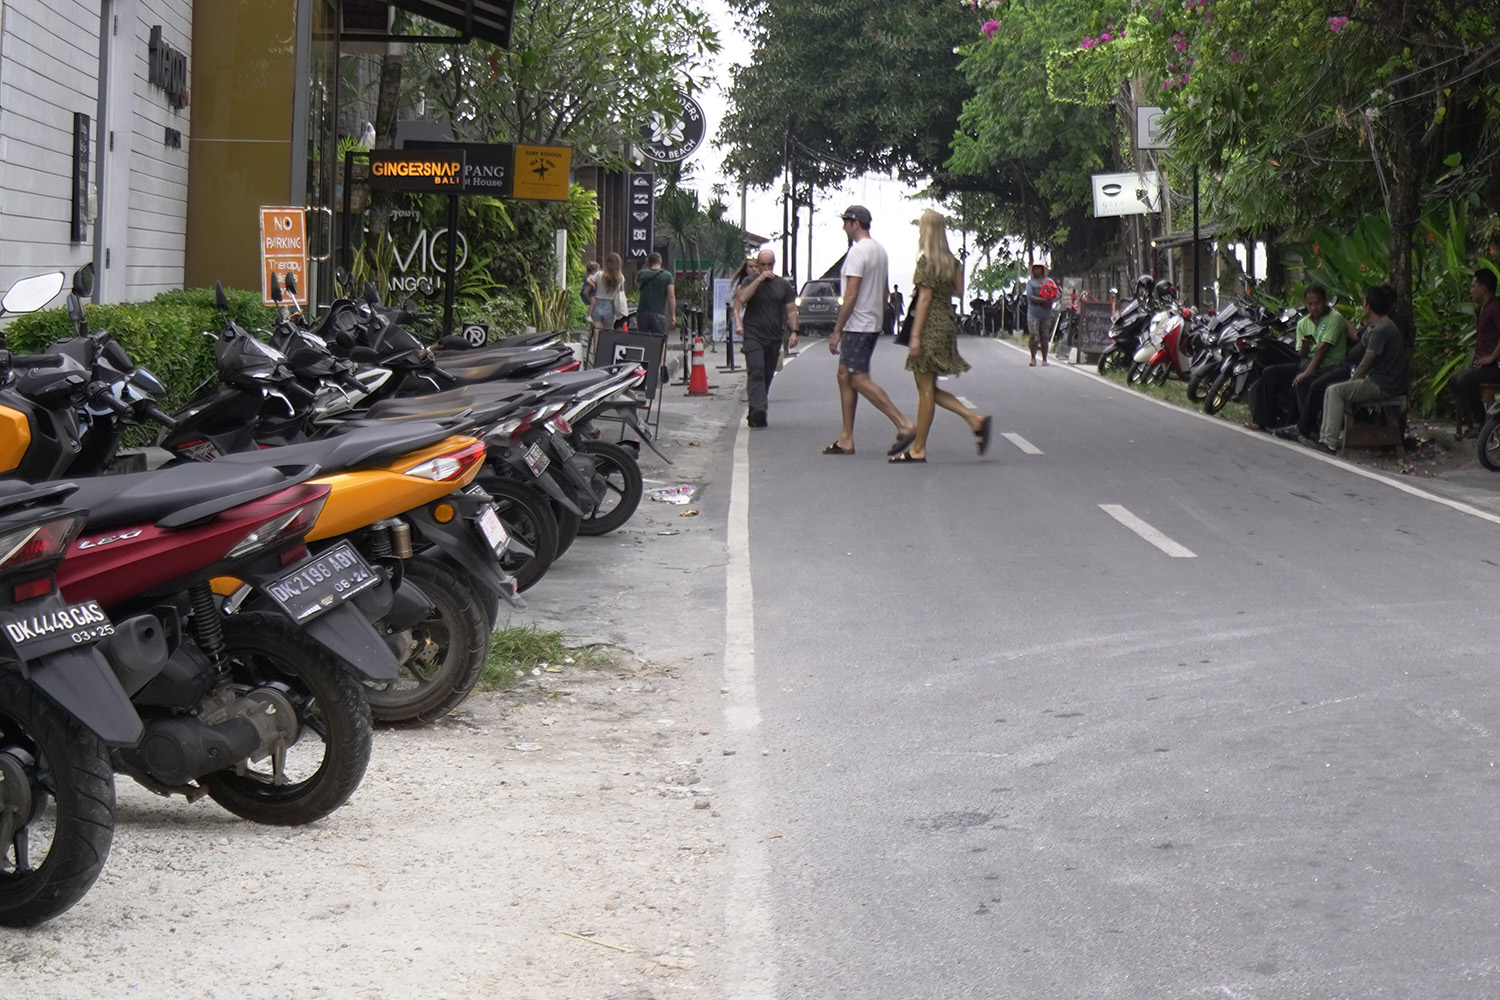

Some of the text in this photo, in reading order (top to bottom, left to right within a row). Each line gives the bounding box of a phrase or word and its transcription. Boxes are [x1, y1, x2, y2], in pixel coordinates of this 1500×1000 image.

[675, 98, 700, 121] DERS
[668, 138, 697, 159] BEACH
[372, 161, 460, 177] GINGERSNAP
[464, 165, 505, 178] PANG
[434, 176, 460, 184] BALI
[473, 177, 503, 188] House
[273, 216, 293, 231] NO
[266, 237, 301, 249] PARKING
[268, 259, 302, 272] Therapy
[177, 440, 203, 449] HONDA
[271, 580, 301, 602] DK
[293, 563, 332, 592] 2198
[328, 550, 357, 572] ABY
[6, 604, 105, 643] DK 4448 GAS
